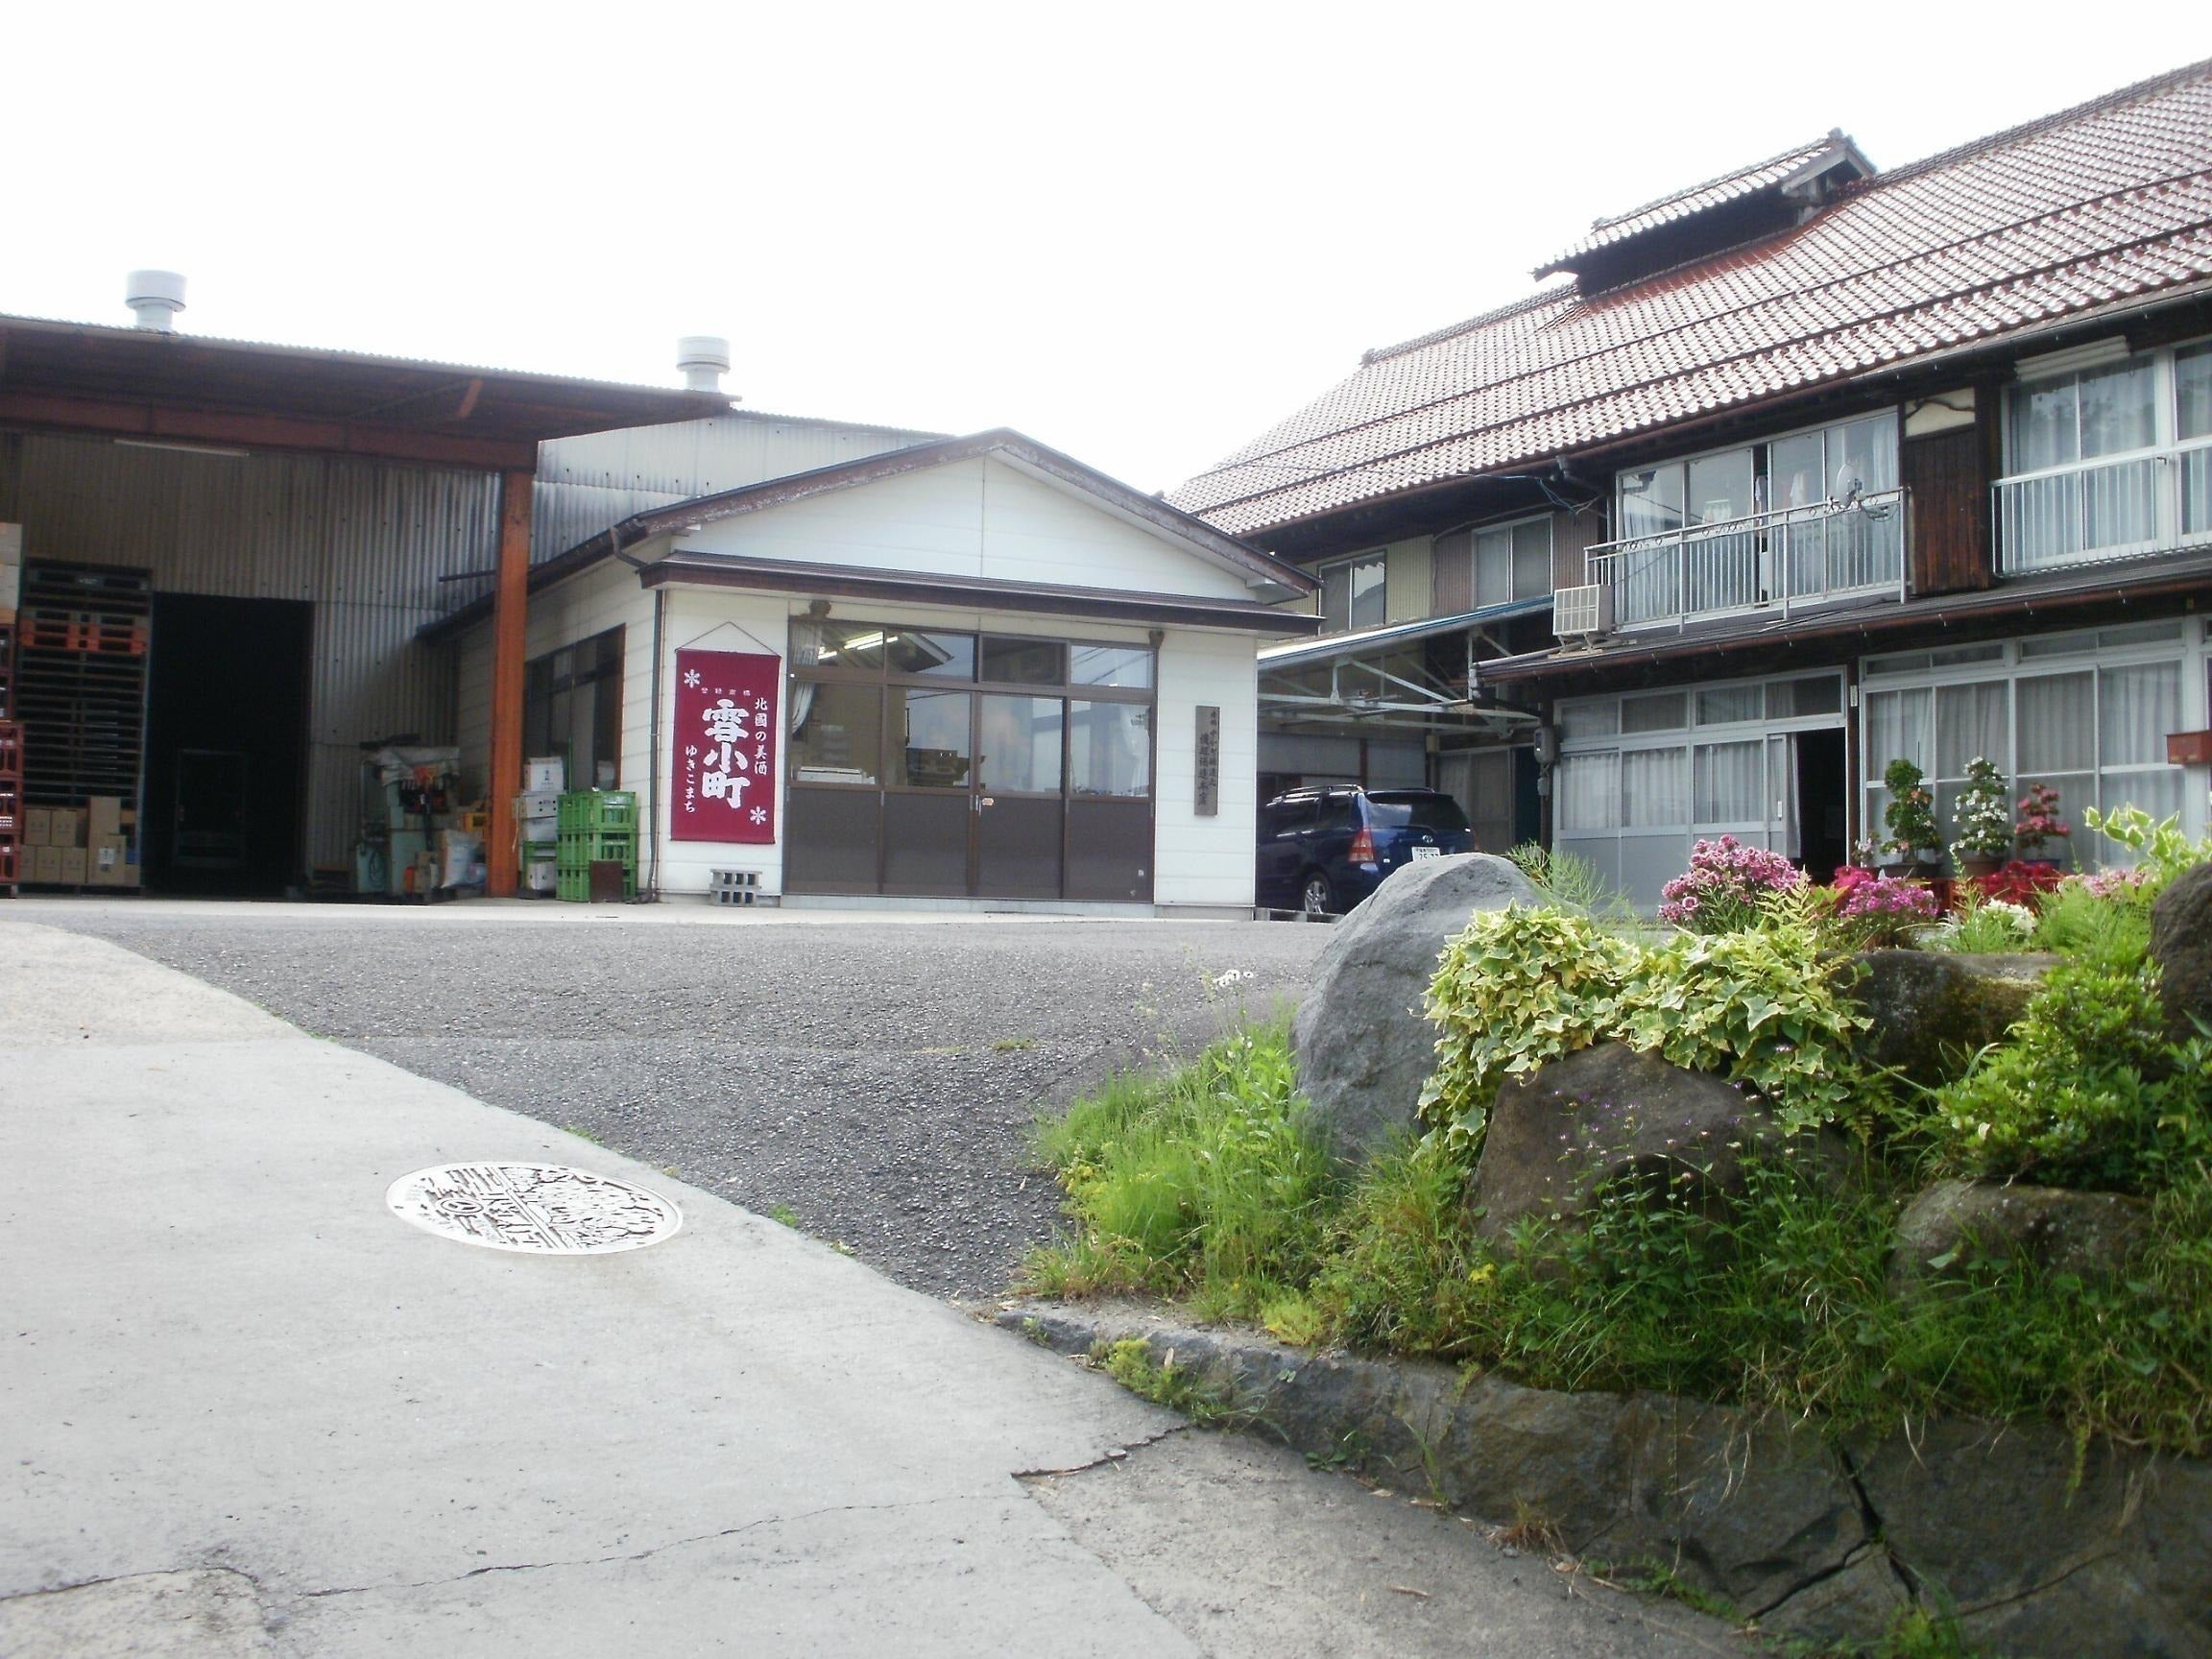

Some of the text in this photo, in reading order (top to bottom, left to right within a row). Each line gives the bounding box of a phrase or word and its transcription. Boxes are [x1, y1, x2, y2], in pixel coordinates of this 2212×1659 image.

[684, 744, 698, 813] ゆきこまち
[702, 699, 750, 808] 雪小町
